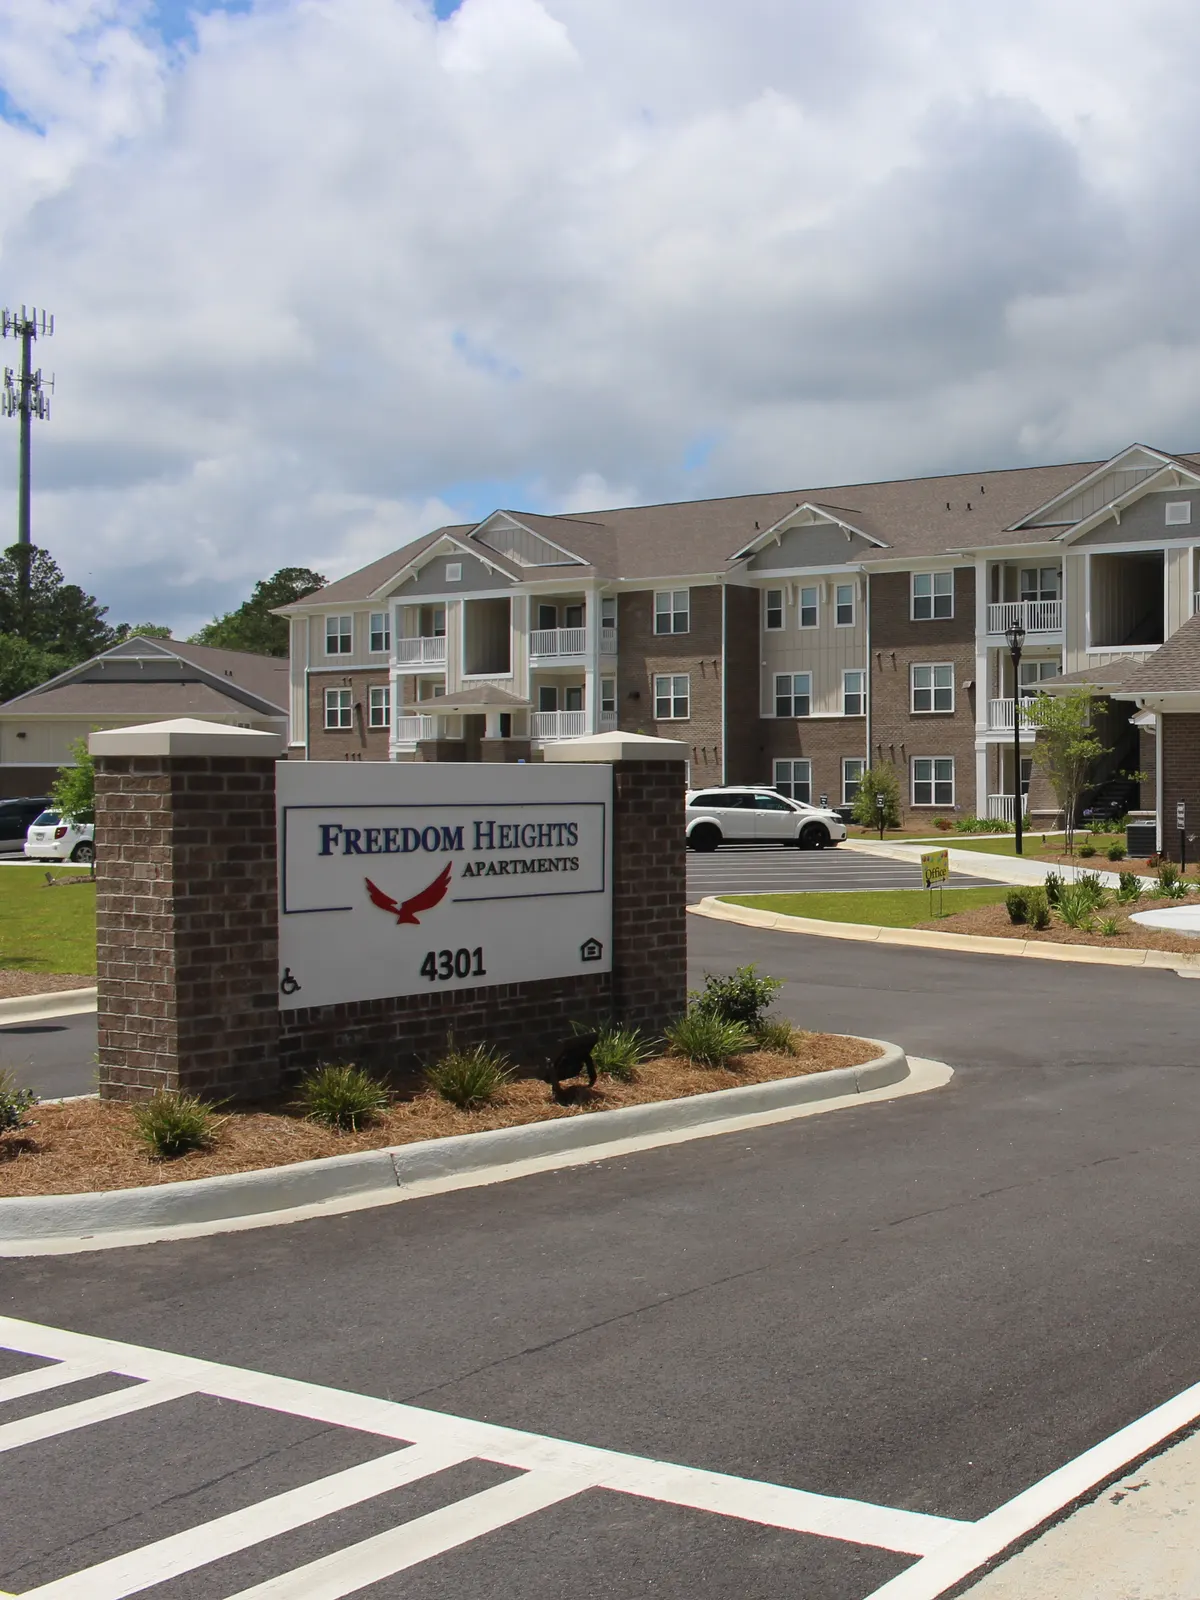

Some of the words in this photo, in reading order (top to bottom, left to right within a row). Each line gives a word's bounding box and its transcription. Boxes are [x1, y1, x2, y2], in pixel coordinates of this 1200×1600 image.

[317, 824, 465, 856] FREEDOM
[473, 820, 579, 850] HEIGHTS
[461, 856, 580, 878] APARTMENTS
[926, 867, 946, 880] Office
[420, 947, 487, 982] 4301
